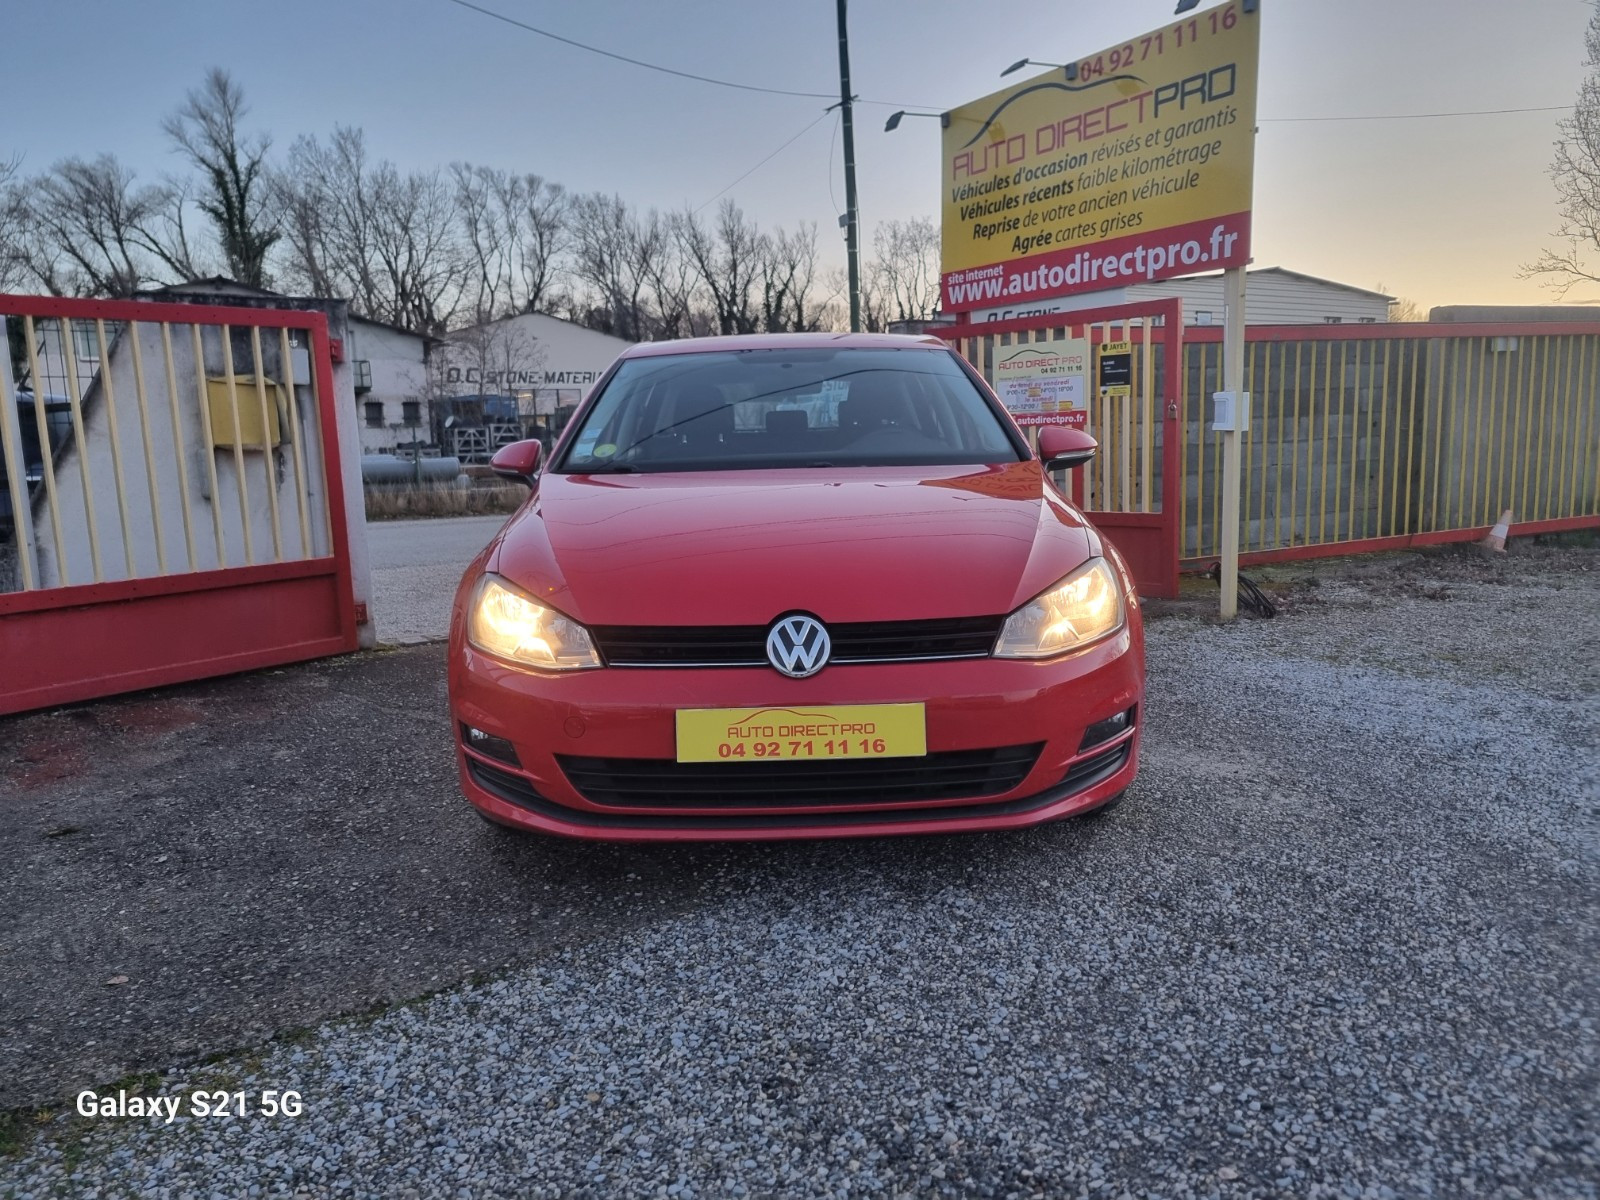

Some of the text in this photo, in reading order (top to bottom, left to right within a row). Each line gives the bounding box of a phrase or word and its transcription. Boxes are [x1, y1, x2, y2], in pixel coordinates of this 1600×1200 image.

[1081, 4, 1237, 82] 04 92 71 11 16
[952, 105, 1237, 203] Véhicules d'occasion révisés et garantis
[953, 133, 1025, 181] AUTO
[960, 140, 1222, 221] Véhicules récents faible kilométrage
[973, 169, 1200, 240] Reprise de votre ancien véhicule
[1011, 211, 1144, 255] Agrée cartes grises
[948, 225, 1237, 305] www.autodirectpro.fr
[948, 265, 1003, 285] site internet
[486, 370, 602, 384] STONE-MATERI
[998, 356, 1083, 370] AUTO DIRECT PRO
[767, 616, 830, 676] VW
[718, 739, 886, 757] 04 92 71 11 16
[727, 726, 774, 738] AUTO
